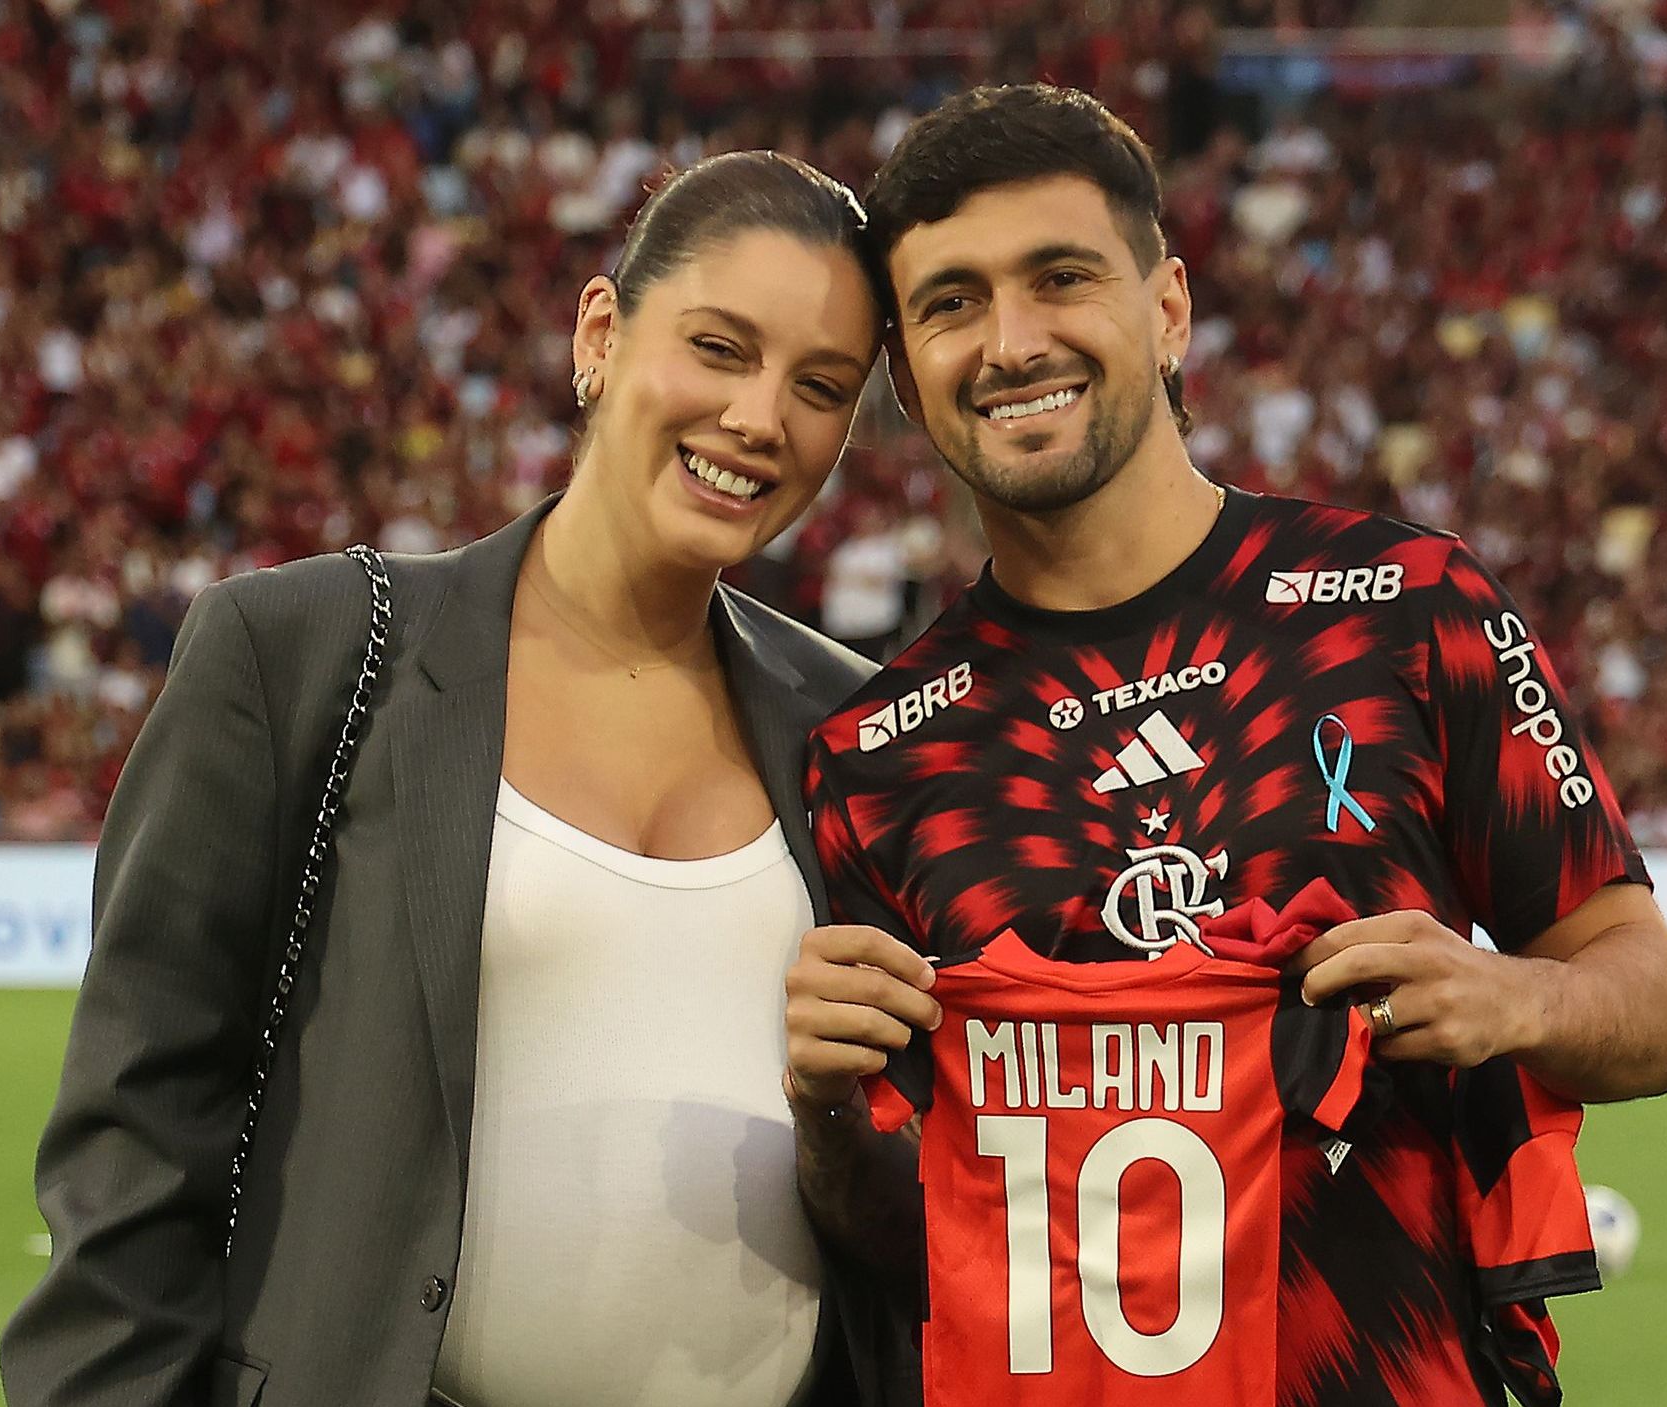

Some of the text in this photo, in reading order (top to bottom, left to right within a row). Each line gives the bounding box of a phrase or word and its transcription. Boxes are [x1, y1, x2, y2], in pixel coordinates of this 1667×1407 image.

[1312, 564, 1404, 603] BRB
[899, 662, 974, 733] BRB
[1092, 662, 1227, 716] TEXACO
[1483, 611, 1593, 809] Shopee
[966, 1019, 1224, 1112] MILANO
[976, 1115, 1226, 1377] 10
